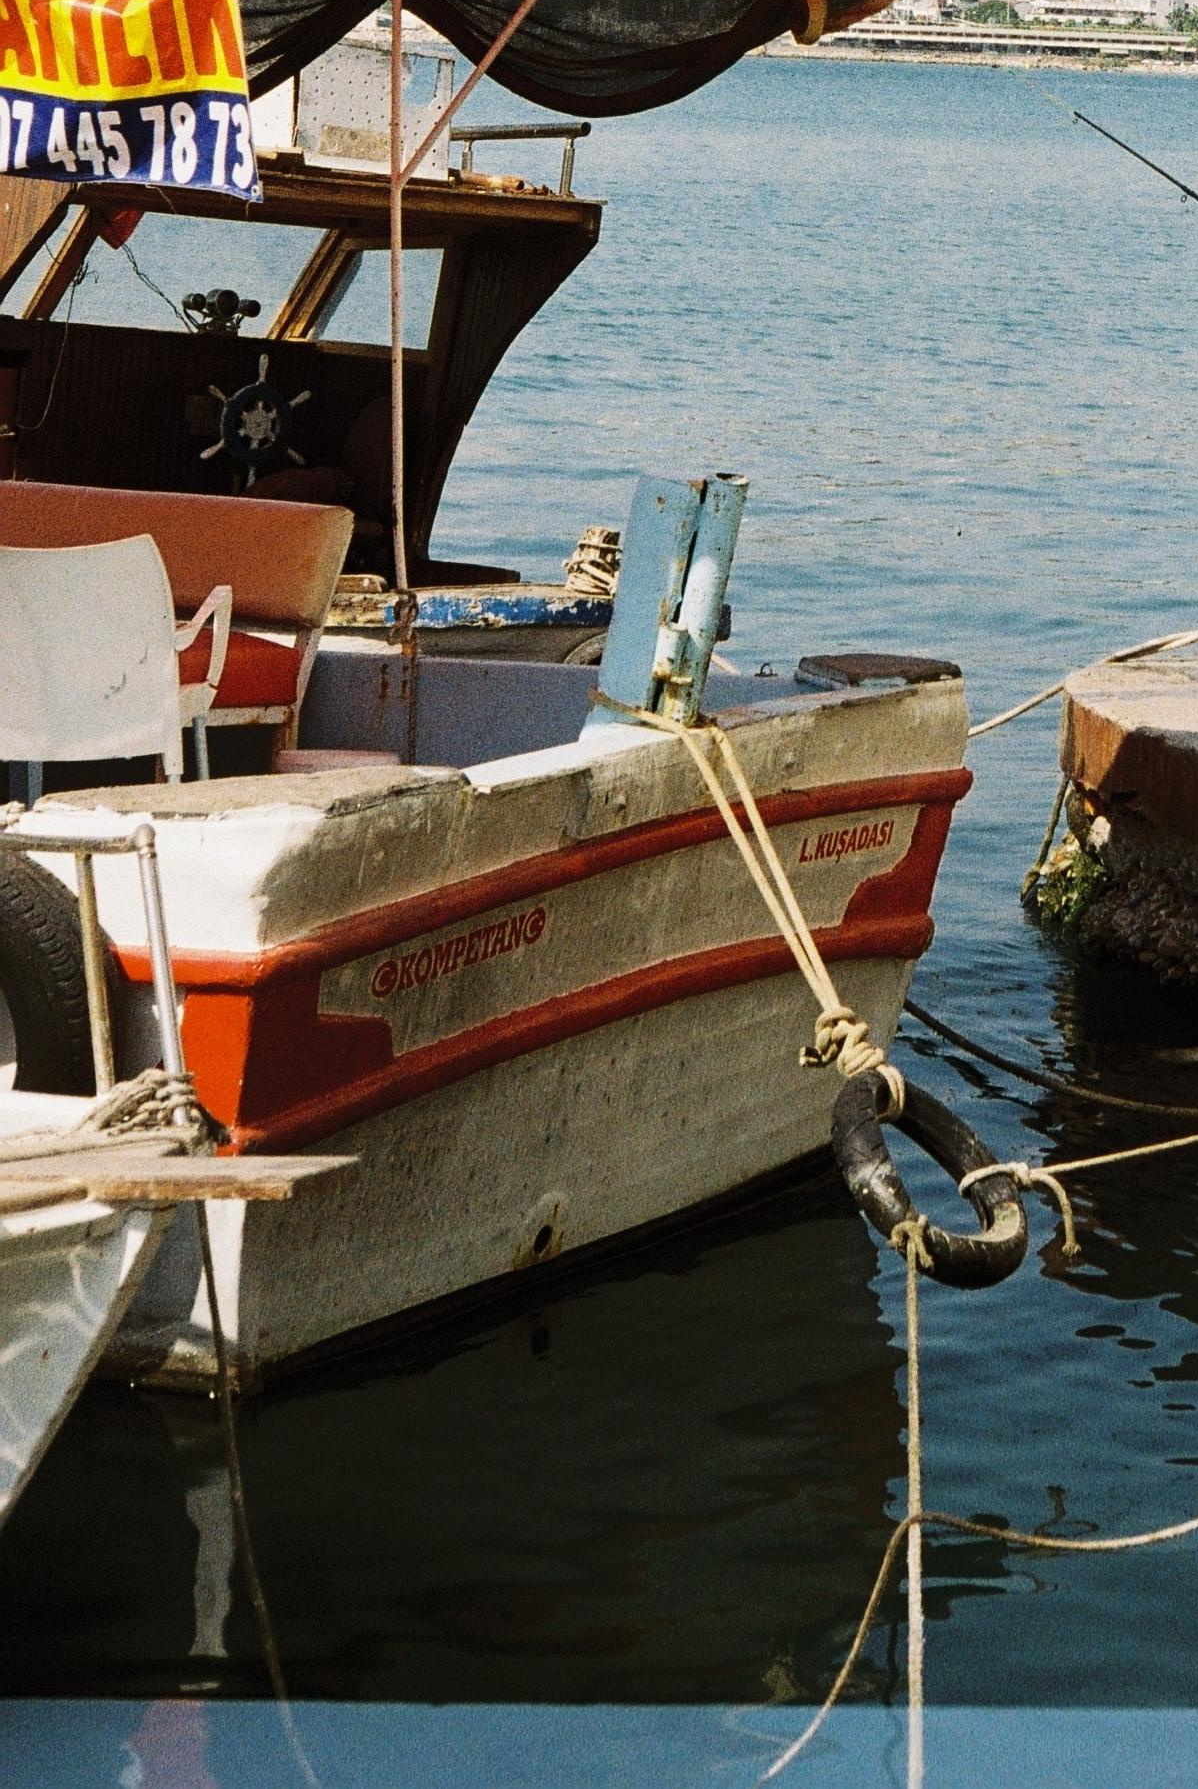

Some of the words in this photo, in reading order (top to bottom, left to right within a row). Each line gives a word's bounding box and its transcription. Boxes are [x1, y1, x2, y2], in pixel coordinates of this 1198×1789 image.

[47, 107, 131, 178] 445
[140, 101, 198, 183] 78
[209, 101, 251, 188] 73
